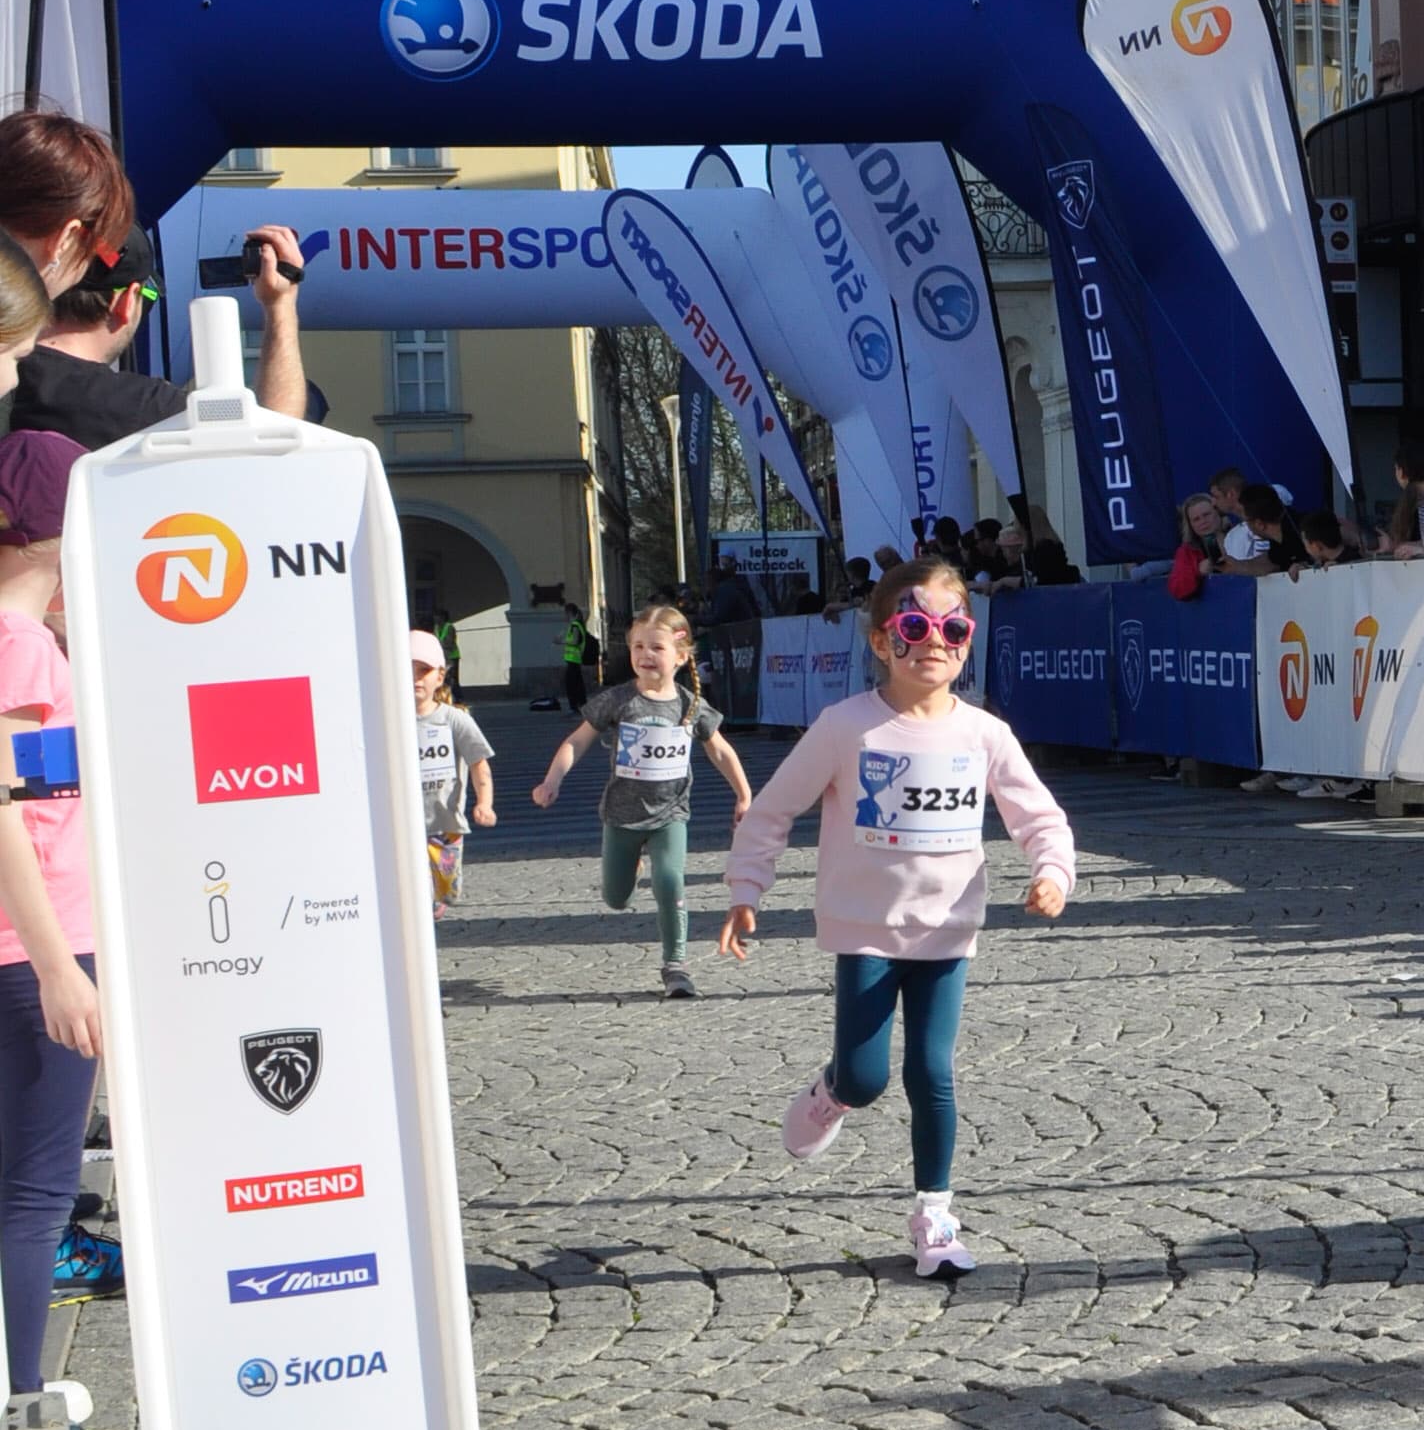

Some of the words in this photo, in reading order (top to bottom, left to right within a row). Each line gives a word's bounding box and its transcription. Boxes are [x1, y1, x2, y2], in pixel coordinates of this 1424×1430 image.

[1072, 246, 1135, 531] PEUGEOT
[267, 540, 346, 578] NN
[1020, 649, 1106, 681] PEUGEOT
[1151, 648, 1251, 689] PEUGEOT
[1314, 653, 1335, 685] NN
[1374, 649, 1404, 683] NN
[641, 744, 686, 759] 3024
[208, 763, 305, 793] AVON
[901, 786, 978, 811] 3234
[303, 894, 360, 911] Powered
[305, 912, 321, 927] by
[325, 908, 360, 923] MVM
[182, 955, 264, 978] innogy
[247, 1035, 313, 1050] PEUGEOT
[232, 1173, 359, 1206] NUTREND
[284, 1351, 388, 1387] ŠKODA
